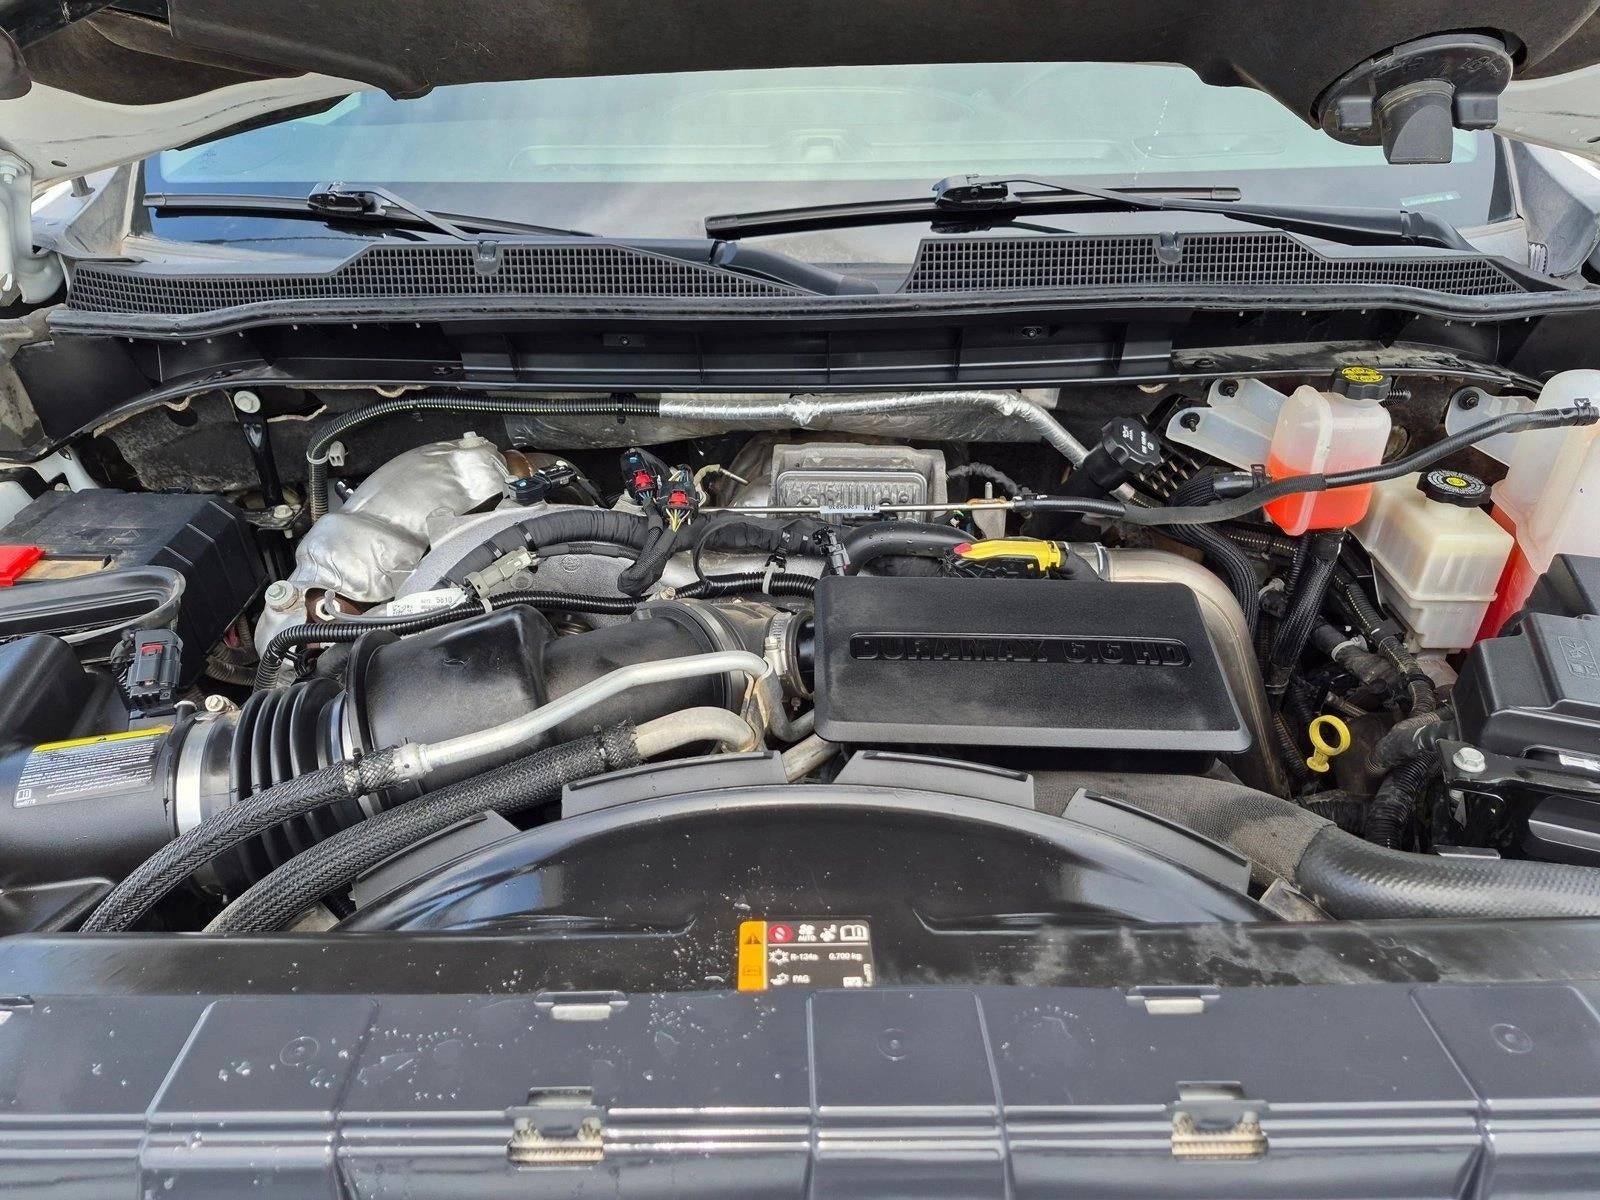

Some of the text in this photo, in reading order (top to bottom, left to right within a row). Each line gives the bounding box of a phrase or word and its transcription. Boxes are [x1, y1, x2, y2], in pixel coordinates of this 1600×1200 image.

[856, 639, 1188, 666] DURAMAX 6.6 HD
[790, 952, 863, 962] R-134a 0.700 kg
[792, 974, 811, 984] PAG
